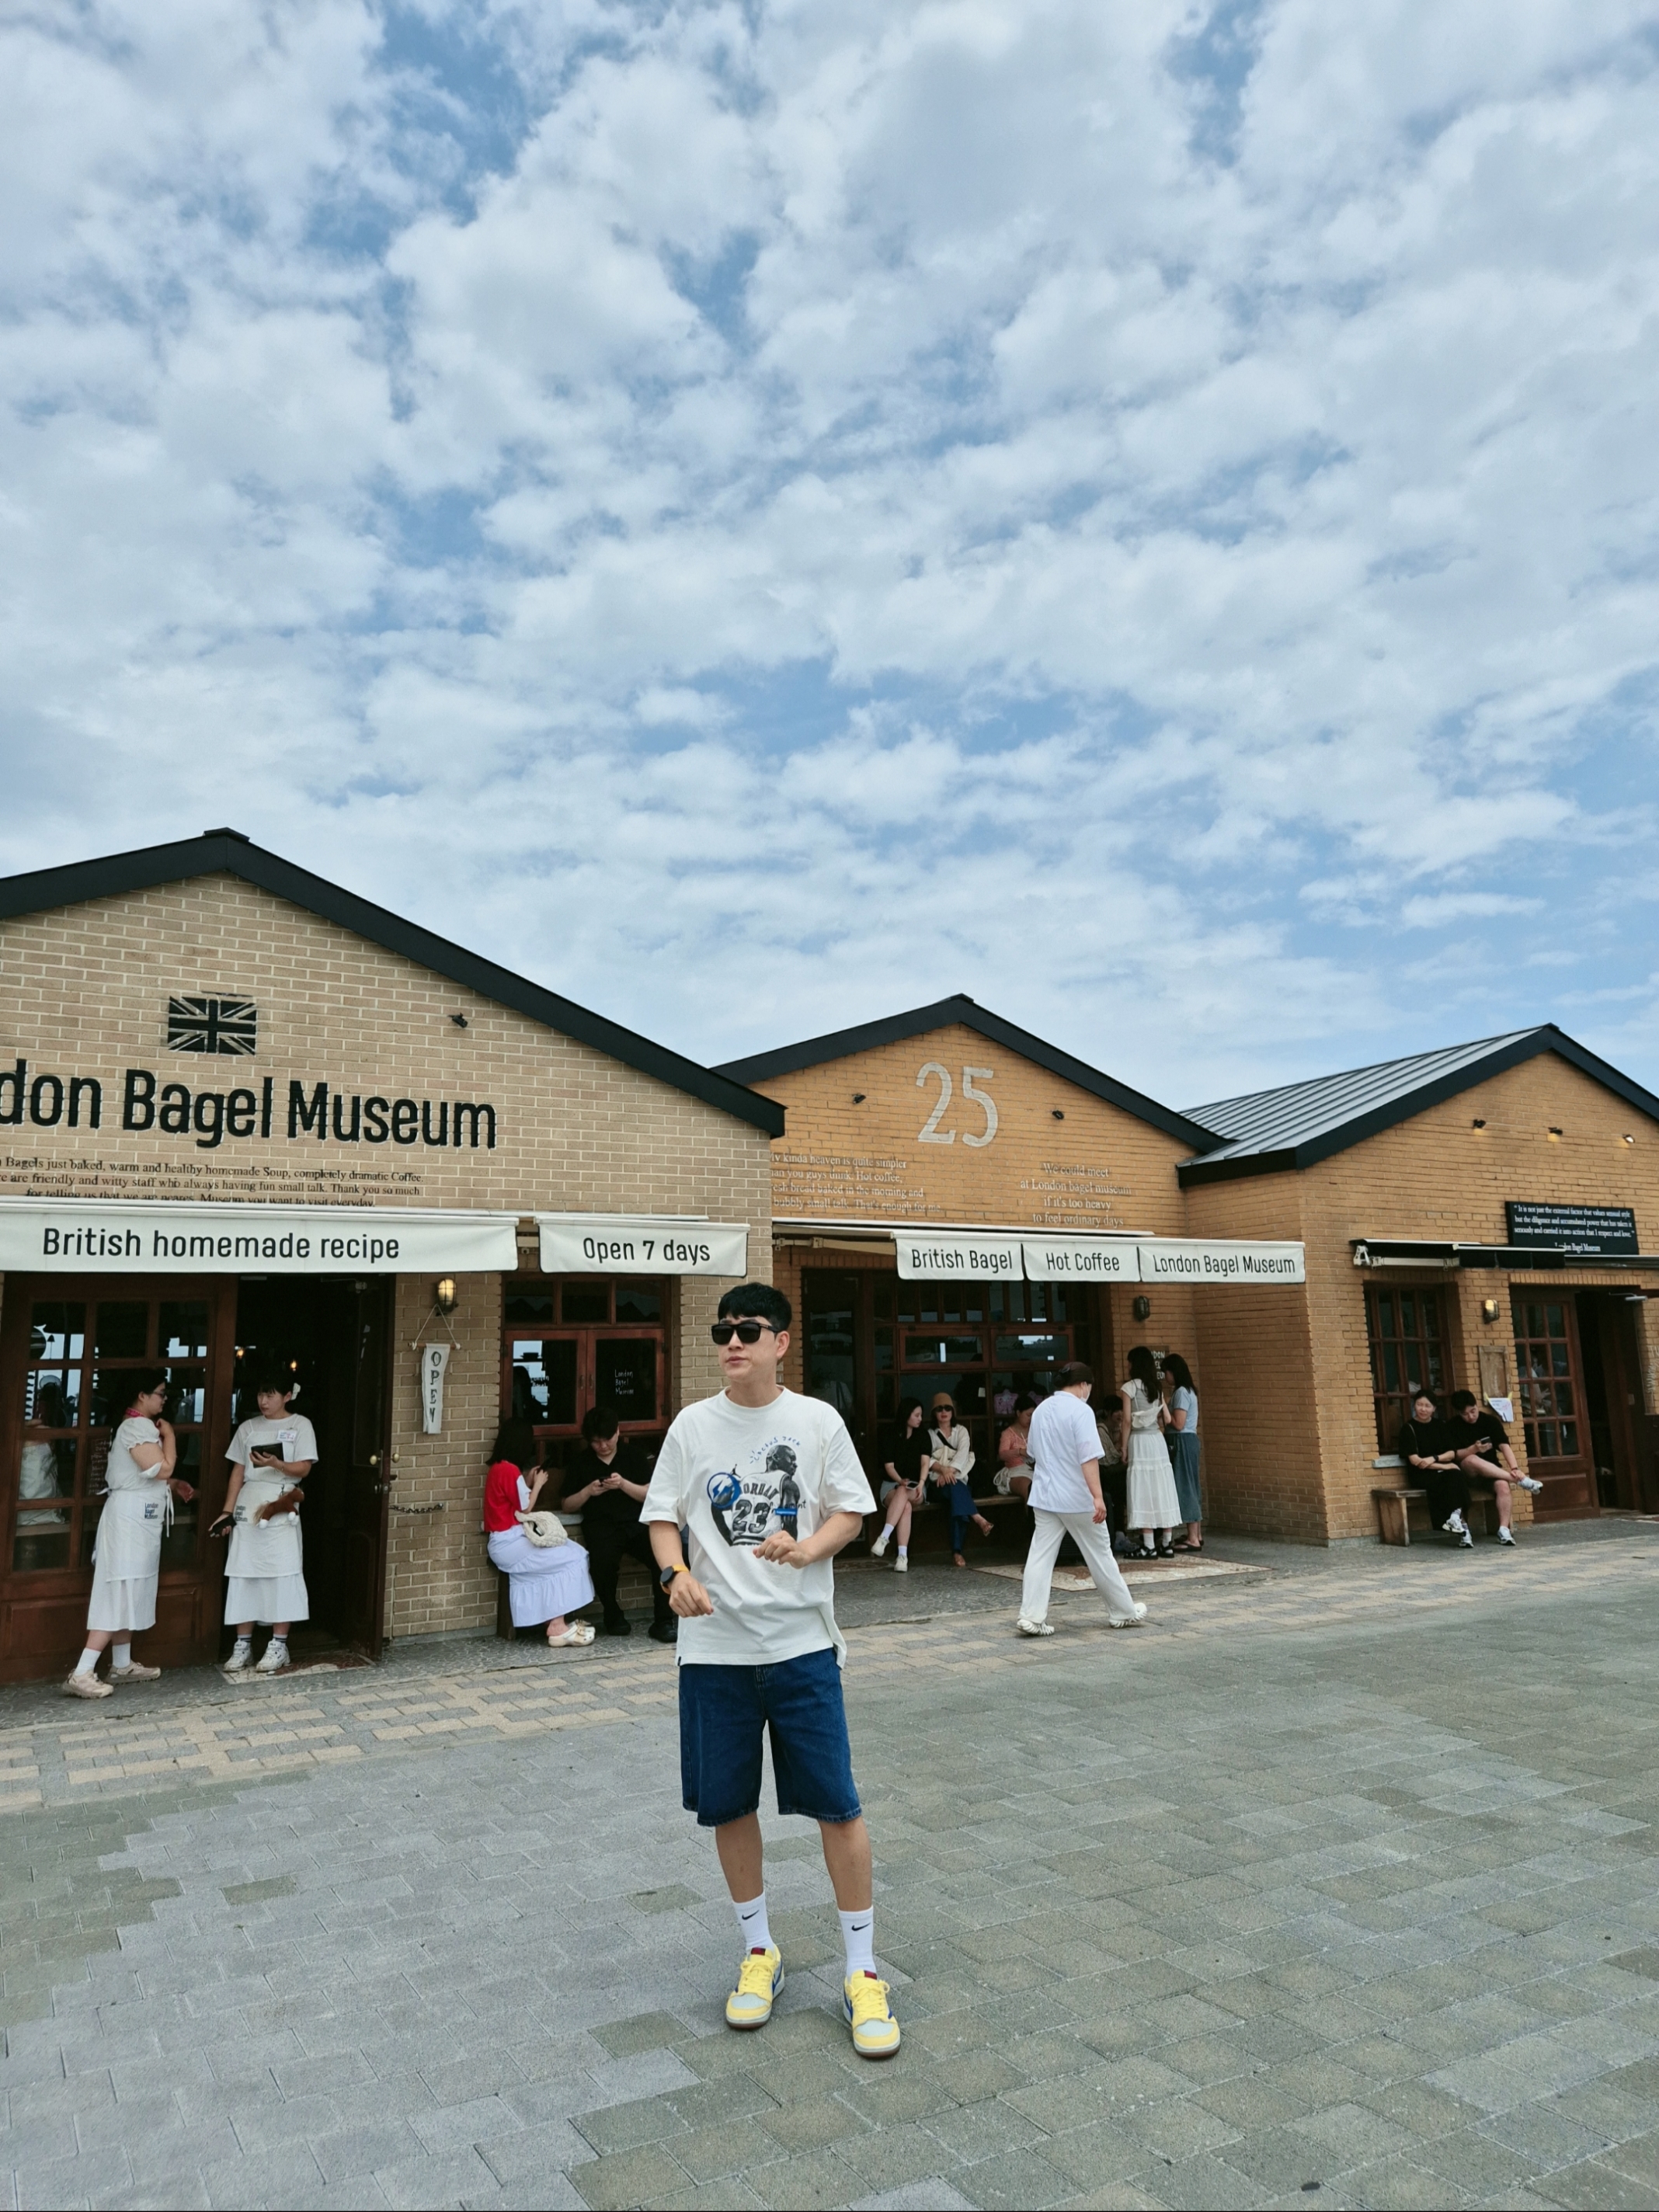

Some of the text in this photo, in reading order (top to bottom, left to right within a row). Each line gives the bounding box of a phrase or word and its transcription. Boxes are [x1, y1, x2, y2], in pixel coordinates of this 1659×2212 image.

[123, 1069, 273, 1148] Bagel
[287, 1080, 496, 1149] Museum
[916, 1062, 998, 1147] 25
[6, 1157, 423, 1182] Bagels just baked, warm and healthy homemade Soup, completely dramatic Coffee.
[783, 1152, 808, 1163] kinda
[809, 1153, 840, 1164] heaven
[843, 1155, 850, 1164] is
[853, 1156, 873, 1168] quite
[875, 1157, 907, 1170] simpler
[1043, 1162, 1109, 1177] We could meet
[11, 1174, 29, 1183] are
[33, 1173, 75, 1186] friendly
[78, 1175, 98, 1185] and
[102, 1176, 128, 1188] witty
[132, 1177, 157, 1187] staff
[159, 1178, 180, 1188] who
[183, 1180, 219, 1191] always
[222, 1180, 256, 1192] having
[259, 1181, 275, 1191] fun
[278, 1182, 304, 1191] small
[307, 1183, 327, 1193] talk.
[331, 1184, 360, 1194] Thank
[363, 1186, 379, 1196] you
[395, 1187, 419, 1195] much
[788, 1170, 804, 1180] you
[806, 1171, 827, 1181] guys
[856, 1170, 872, 1181] Hot
[874, 1171, 902, 1184] coffee,
[1021, 1178, 1132, 1195] at London bagel museum
[791, 1182, 815, 1193] bread
[817, 1183, 843, 1195] baked
[846, 1184, 854, 1195] in
[856, 1184, 869, 1195] the
[871, 1186, 906, 1199] morning
[909, 1188, 923, 1197] and
[774, 1197, 804, 1209] bubbly
[807, 1198, 830, 1208] small
[854, 1198, 879, 1210] That's
[882, 1202, 912, 1213] enough
[914, 1202, 926, 1211] for
[1044, 1195, 1111, 1212] if it's too heavy
[1033, 1212, 1123, 1228] to feel ordinary days
[43, 1228, 399, 1264] British homemade recipe
[583, 1237, 710, 1266] Open 7 days
[912, 1249, 1012, 1274] British Bagel
[1046, 1252, 1120, 1271] Hot Coffee
[1153, 1254, 1296, 1277] London Bagel Museum
[614, 1369, 634, 1379] London
[732, 1499, 770, 1533] 23
